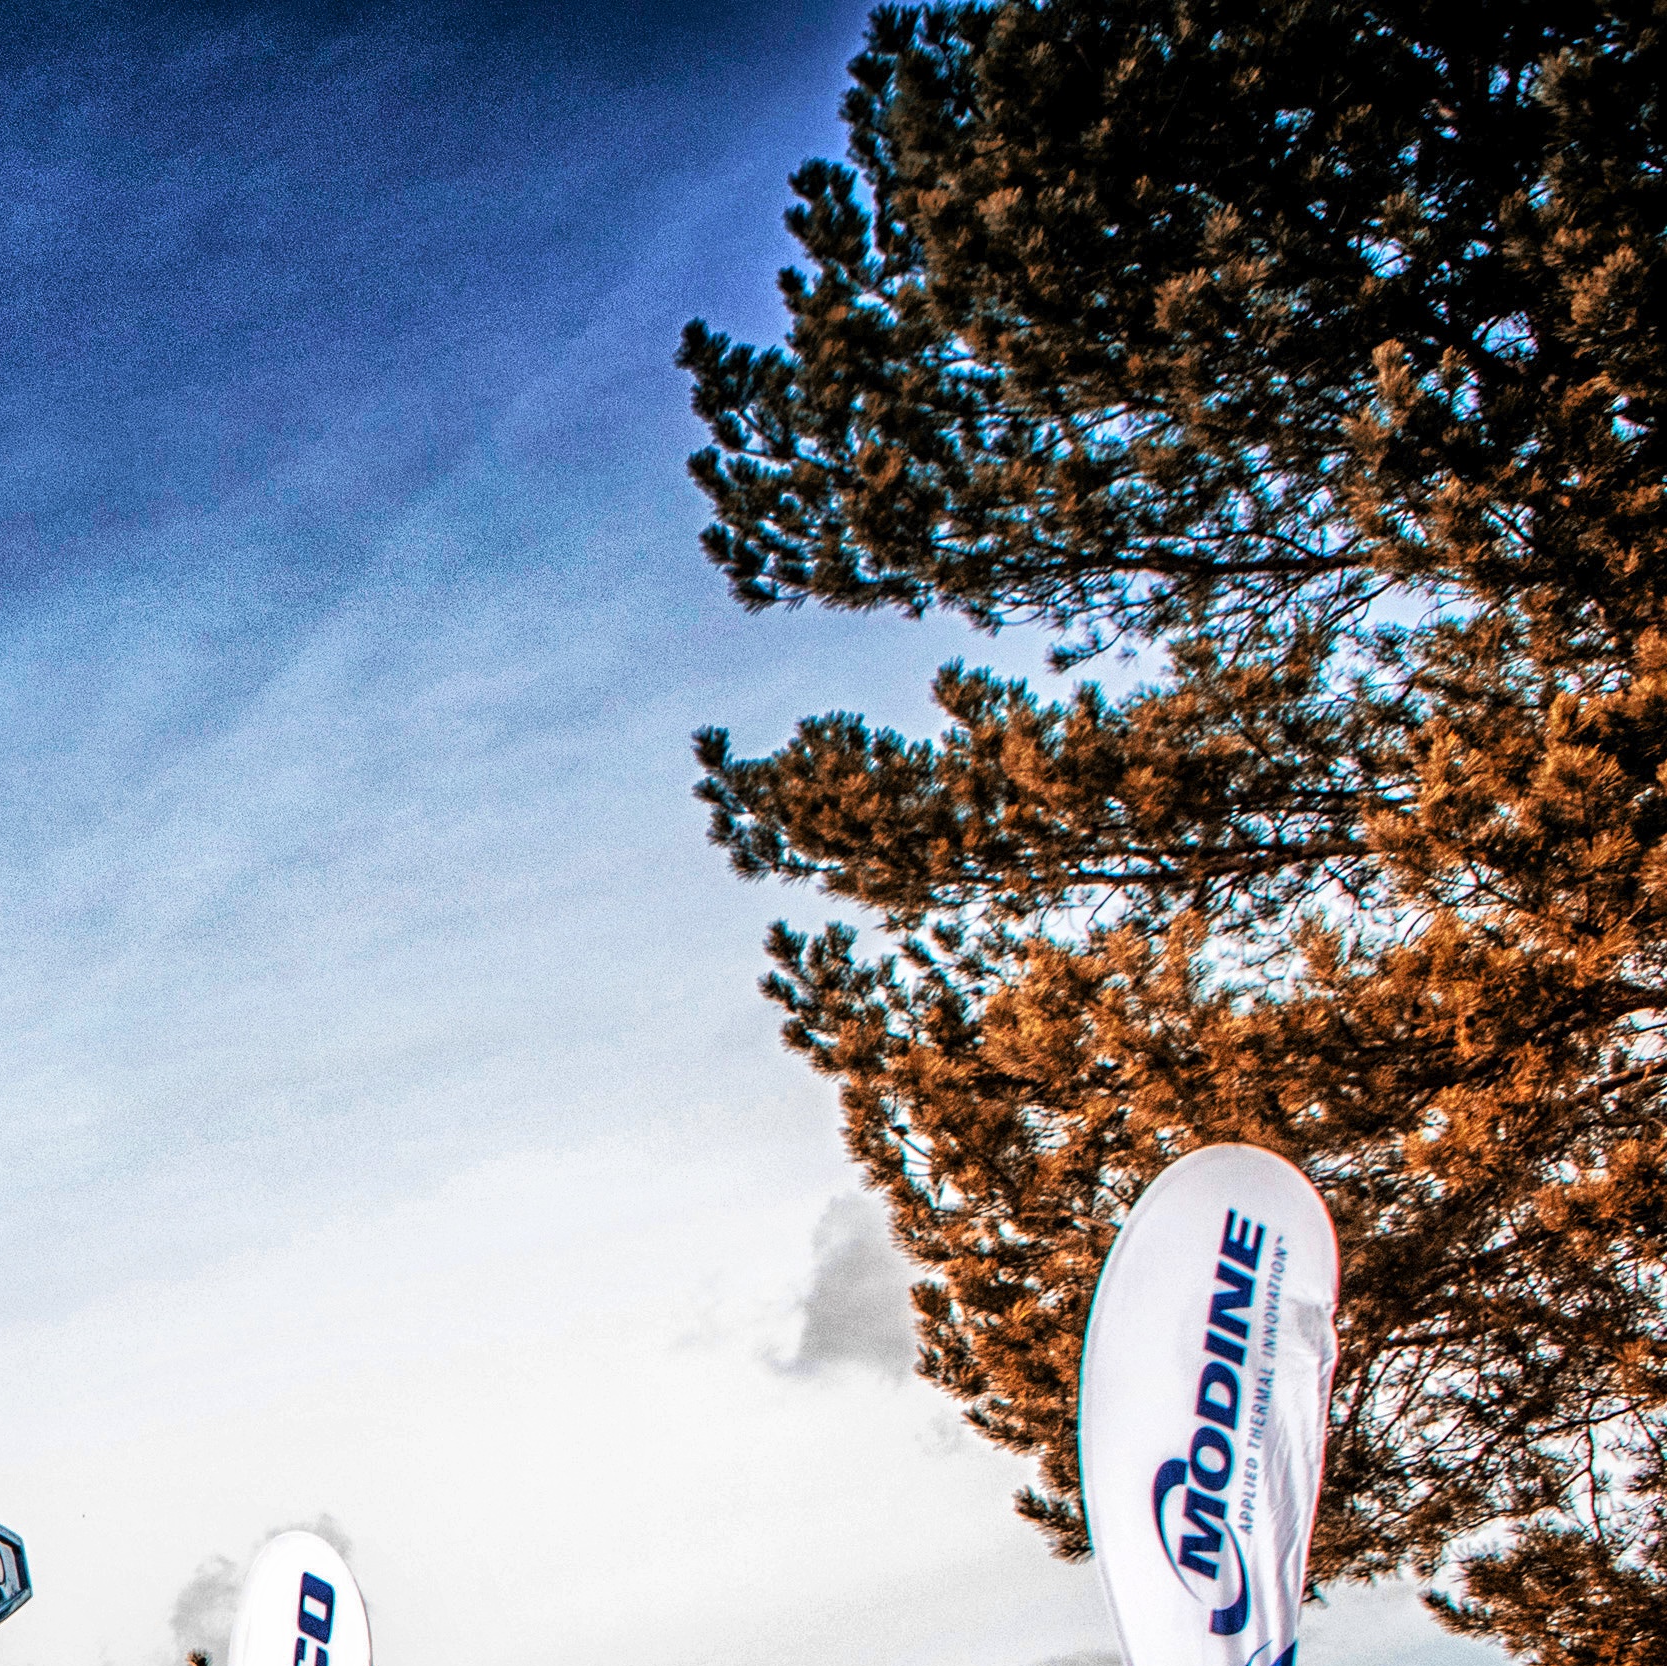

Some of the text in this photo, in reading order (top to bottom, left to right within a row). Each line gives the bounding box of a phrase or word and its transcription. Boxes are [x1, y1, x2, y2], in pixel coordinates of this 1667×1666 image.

[1177, 1208, 1266, 1580] MODINE
[1247, 1367, 1275, 1450] THERMAL
[1237, 1456, 1259, 1536] APPLIED
